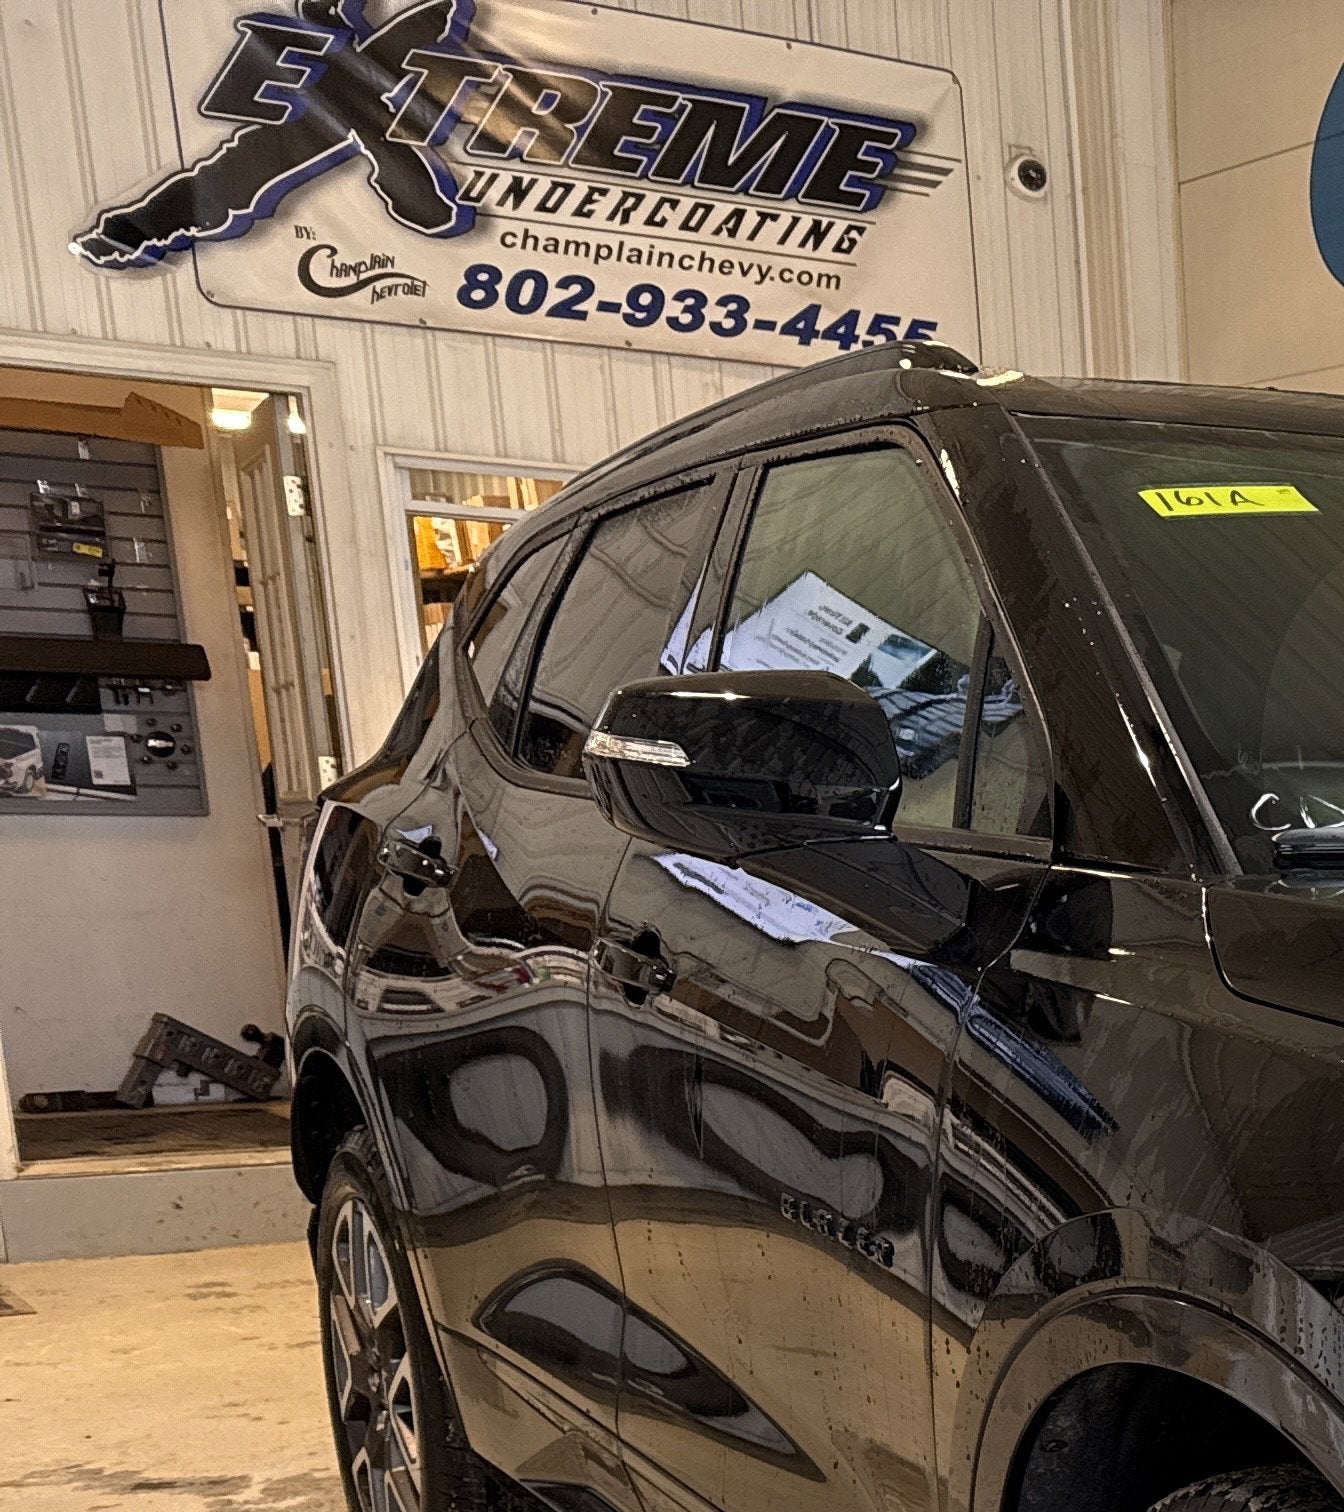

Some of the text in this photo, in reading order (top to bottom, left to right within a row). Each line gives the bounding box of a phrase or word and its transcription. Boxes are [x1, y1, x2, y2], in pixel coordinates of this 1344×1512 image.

[70, 0, 916, 270] EXTREME
[294, 225, 317, 240] BY:
[457, 169, 867, 256] UNDERCOATING
[499, 228, 843, 291] champlainchevy.com
[456, 263, 938, 350] 802-933-4455
[1155, 489, 1265, 512] 161A
